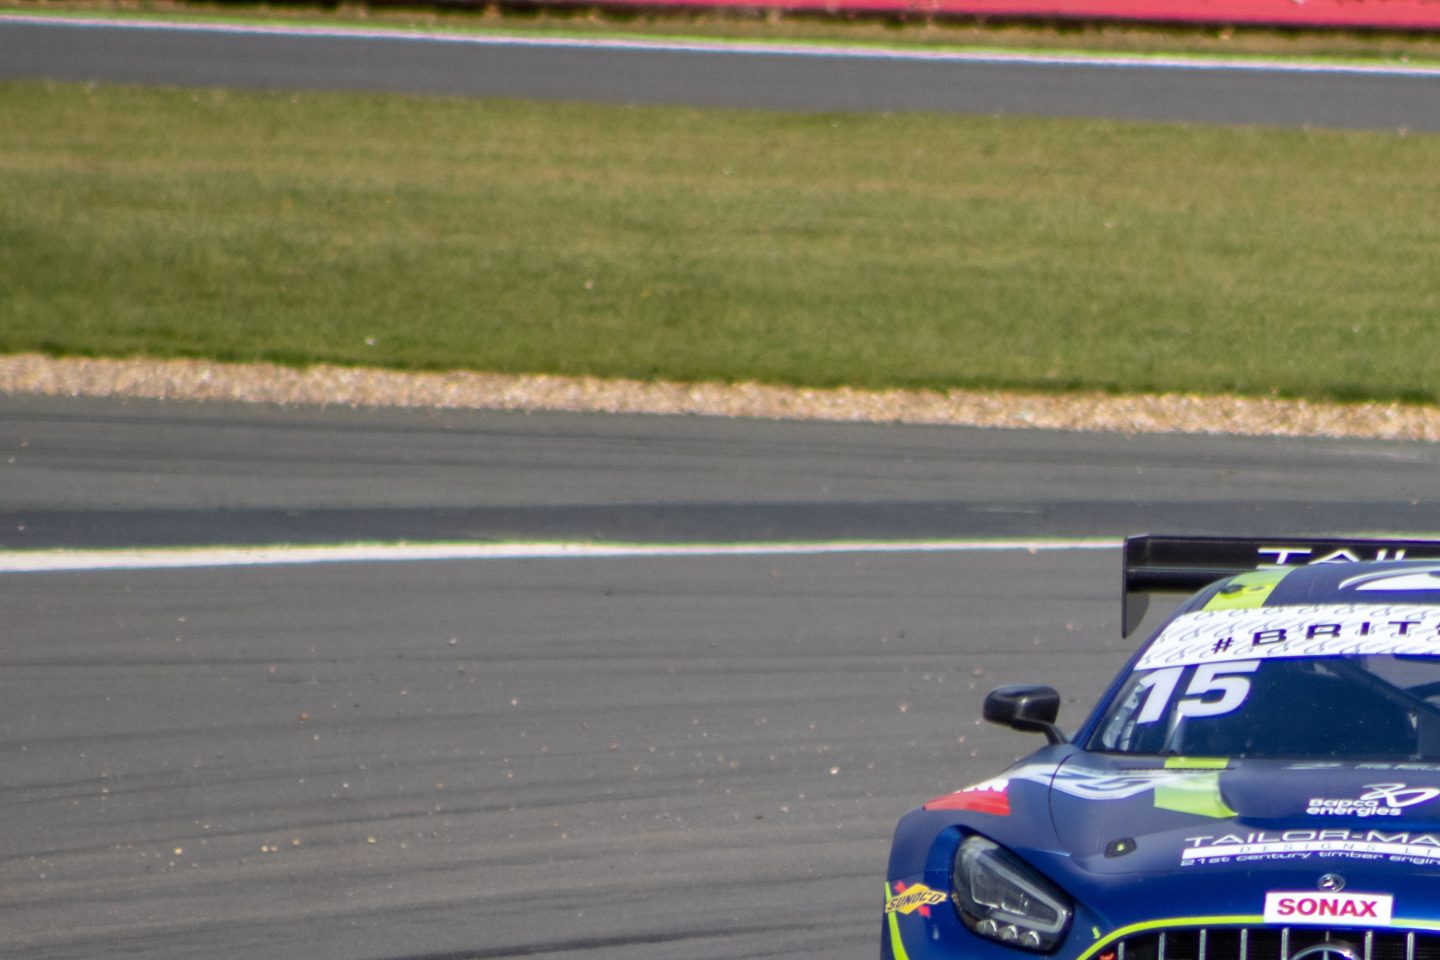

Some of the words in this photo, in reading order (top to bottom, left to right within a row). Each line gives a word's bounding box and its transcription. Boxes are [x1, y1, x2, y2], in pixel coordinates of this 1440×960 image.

[1136, 659, 1261, 725] 15
[1306, 806, 1402, 817] energies
[1239, 842, 1377, 853] DESIGNS
[1180, 857, 1230, 866] 21st
[1236, 851, 1312, 862] century
[1318, 850, 1384, 860] timber
[887, 891, 943, 912] SUNOCO
[1276, 897, 1379, 919] SONAX
